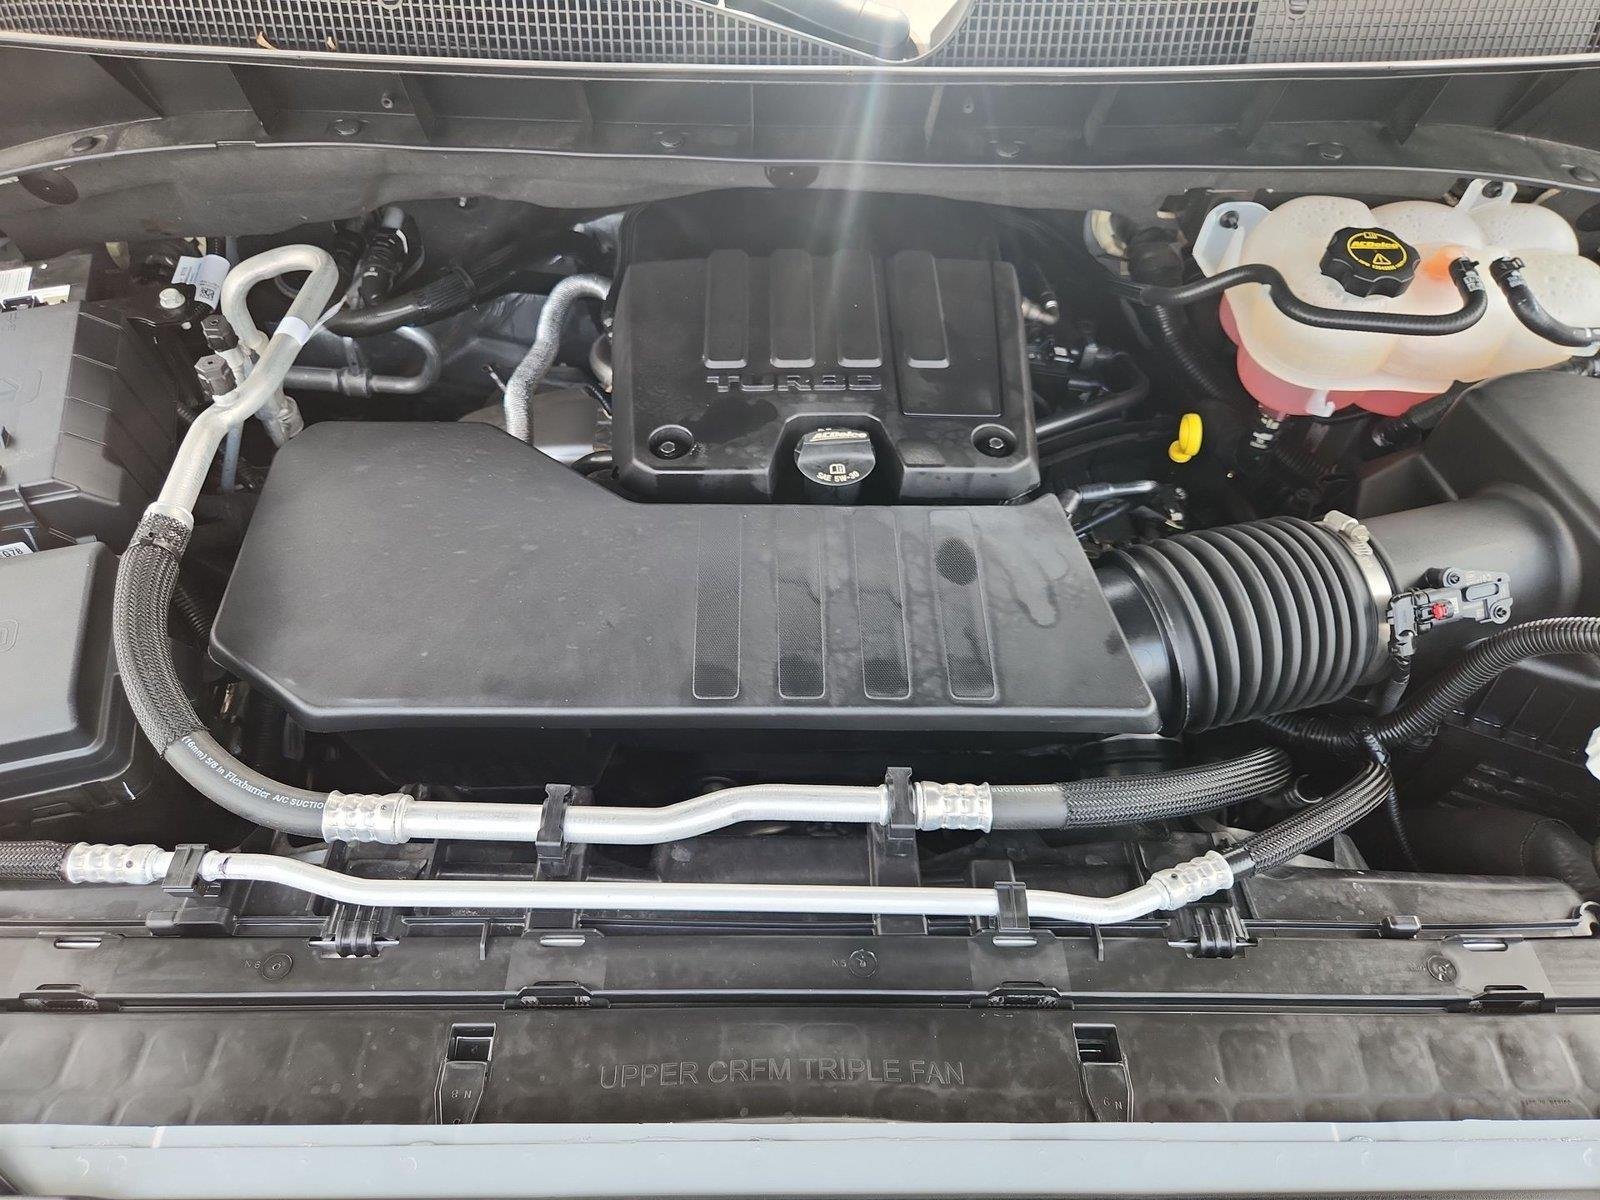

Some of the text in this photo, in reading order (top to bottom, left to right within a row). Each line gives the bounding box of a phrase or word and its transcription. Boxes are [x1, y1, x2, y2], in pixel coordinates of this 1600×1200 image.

[706, 375, 882, 392] TURBO
[816, 470, 860, 483] SAE 5W-30
[272, 793, 290, 804] A/C
[600, 1057, 965, 1090] UPPER CRFM TRIPLE FAN
